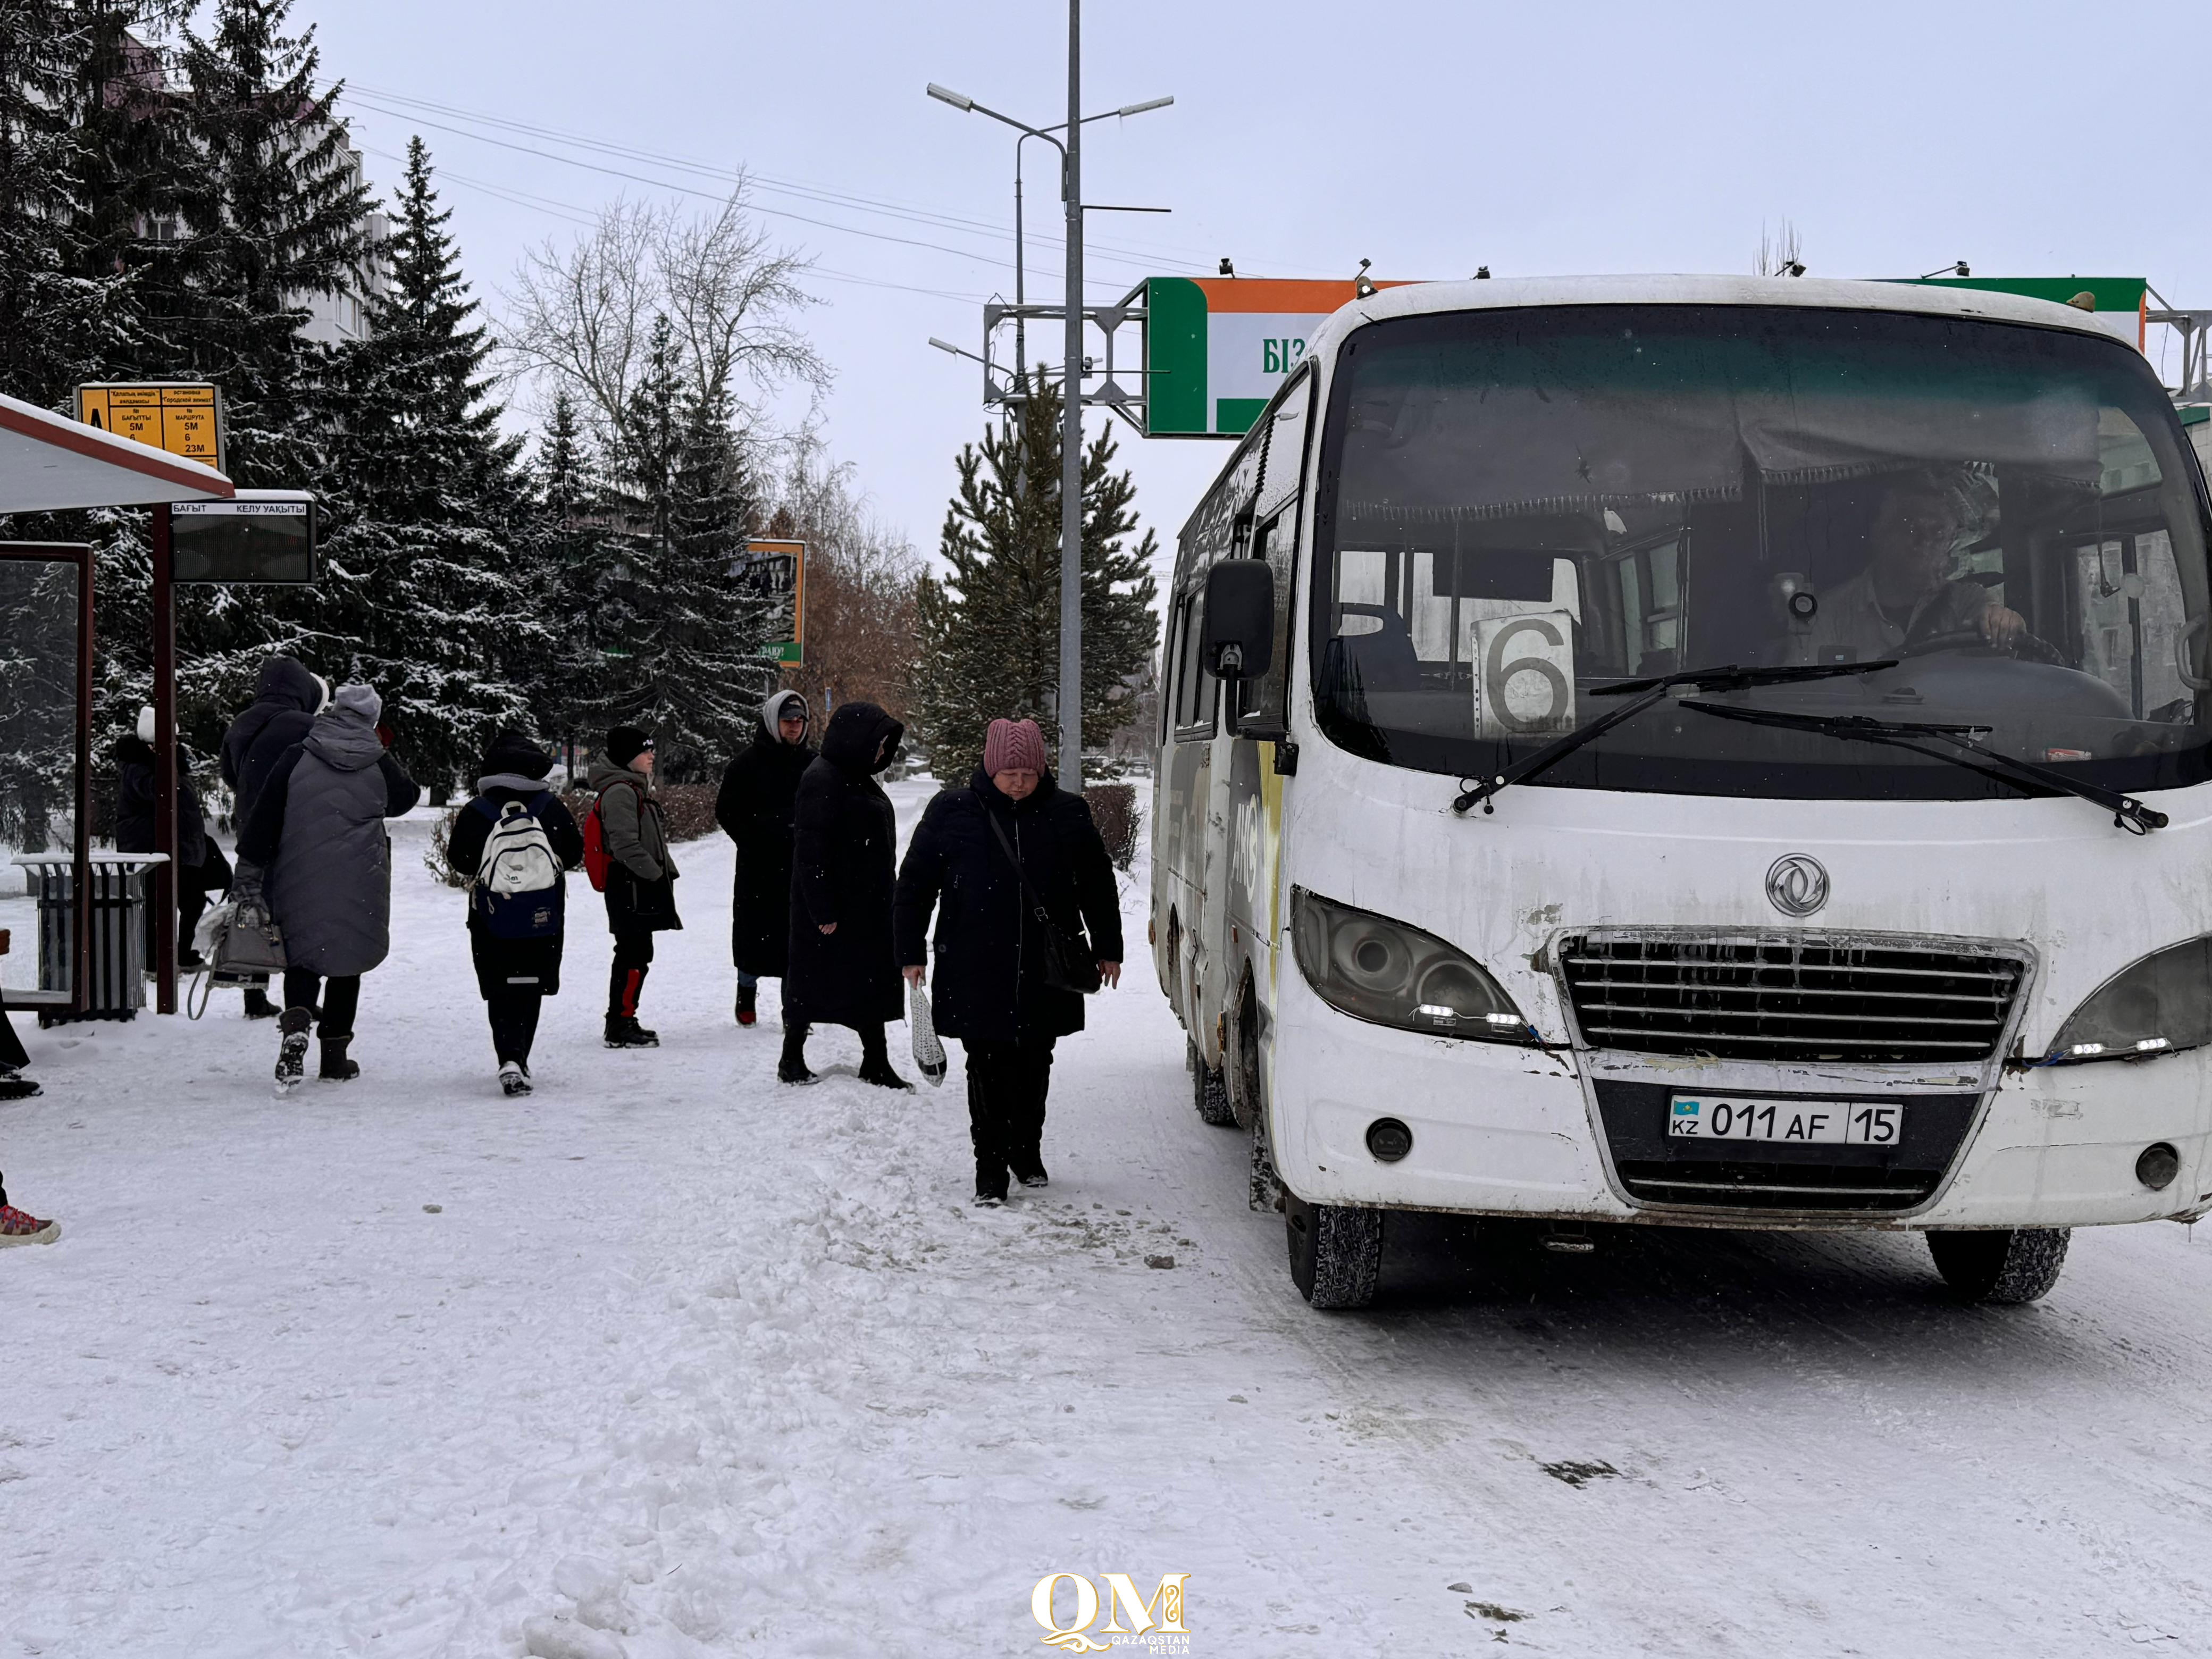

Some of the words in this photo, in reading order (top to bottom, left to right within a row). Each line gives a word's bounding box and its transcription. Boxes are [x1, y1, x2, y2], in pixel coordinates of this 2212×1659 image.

[263, 505, 305, 514] УАҚЫТЫ
[1486, 618, 1569, 733] 6
[1672, 1120, 1699, 1135] KZ
[1711, 1103, 1777, 1138] 011
[1785, 1114, 1830, 1139] AF
[1854, 1109, 1896, 1142] 15
